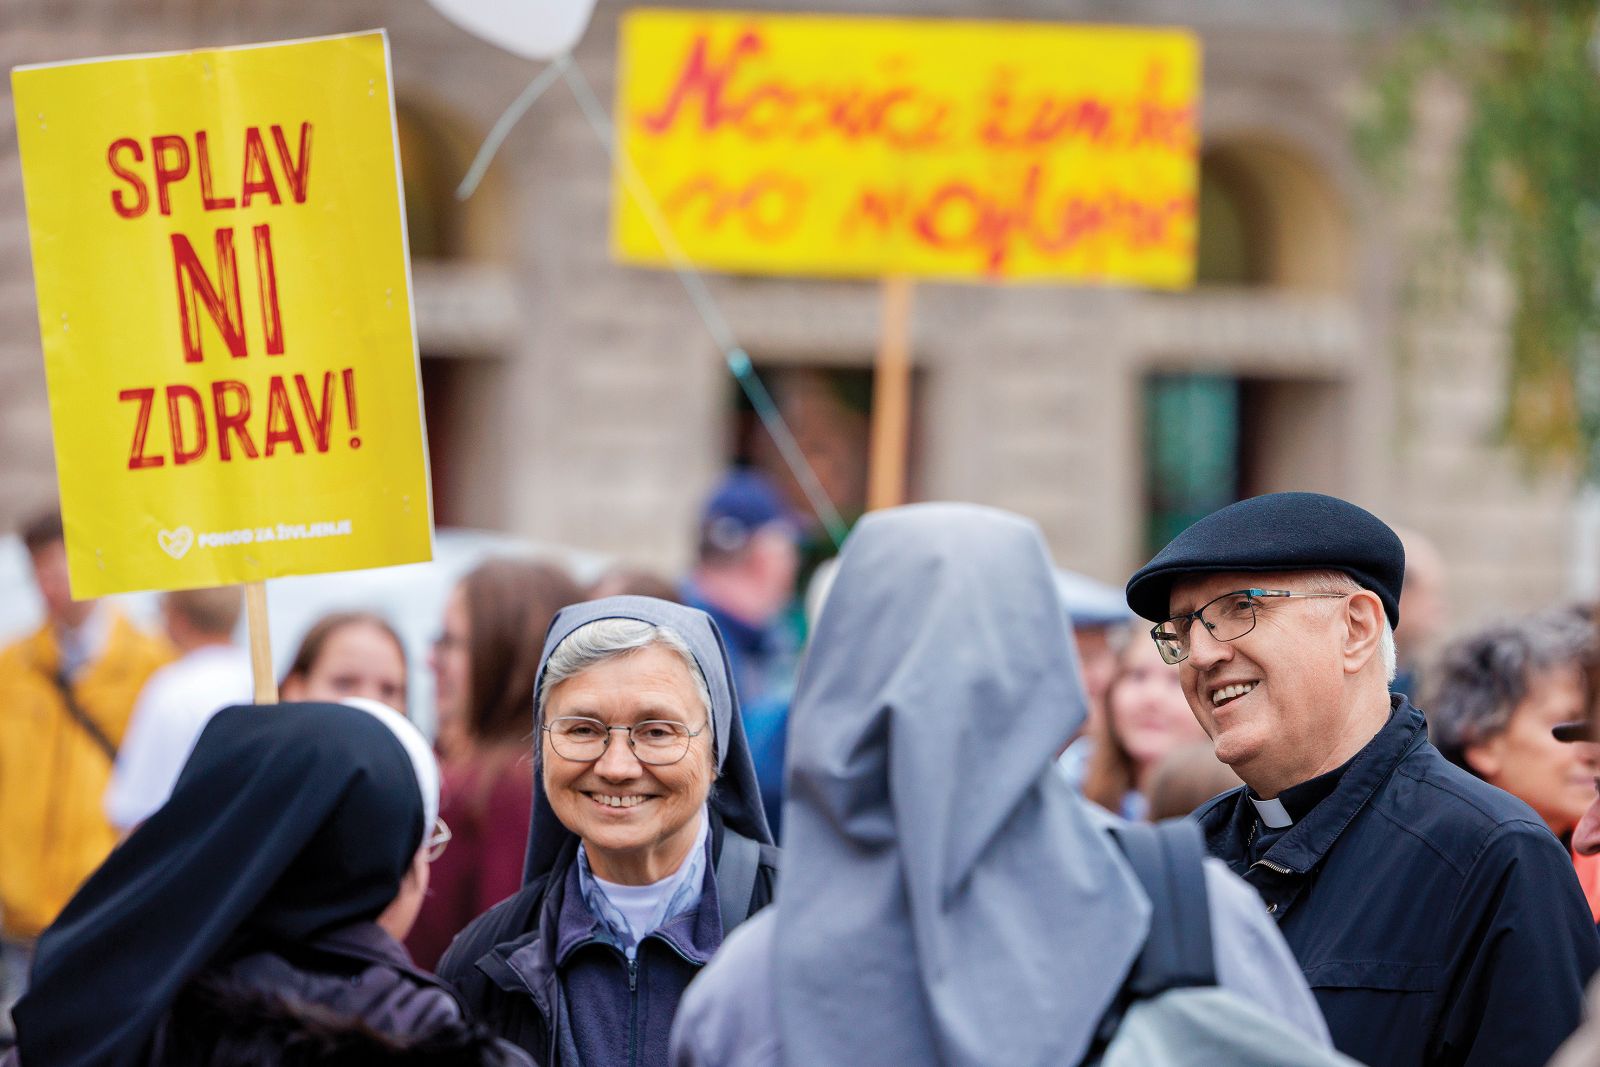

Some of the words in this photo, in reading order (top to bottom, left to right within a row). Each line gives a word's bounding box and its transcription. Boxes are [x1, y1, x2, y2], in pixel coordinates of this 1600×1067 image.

[107, 121, 313, 218] SPLAV
[170, 223, 285, 362] NI
[119, 368, 363, 470] ZDRAV!
[198, 528, 253, 548] POHOD
[254, 526, 275, 543] ZA
[276, 519, 352, 541] ŽIVLJENJE
